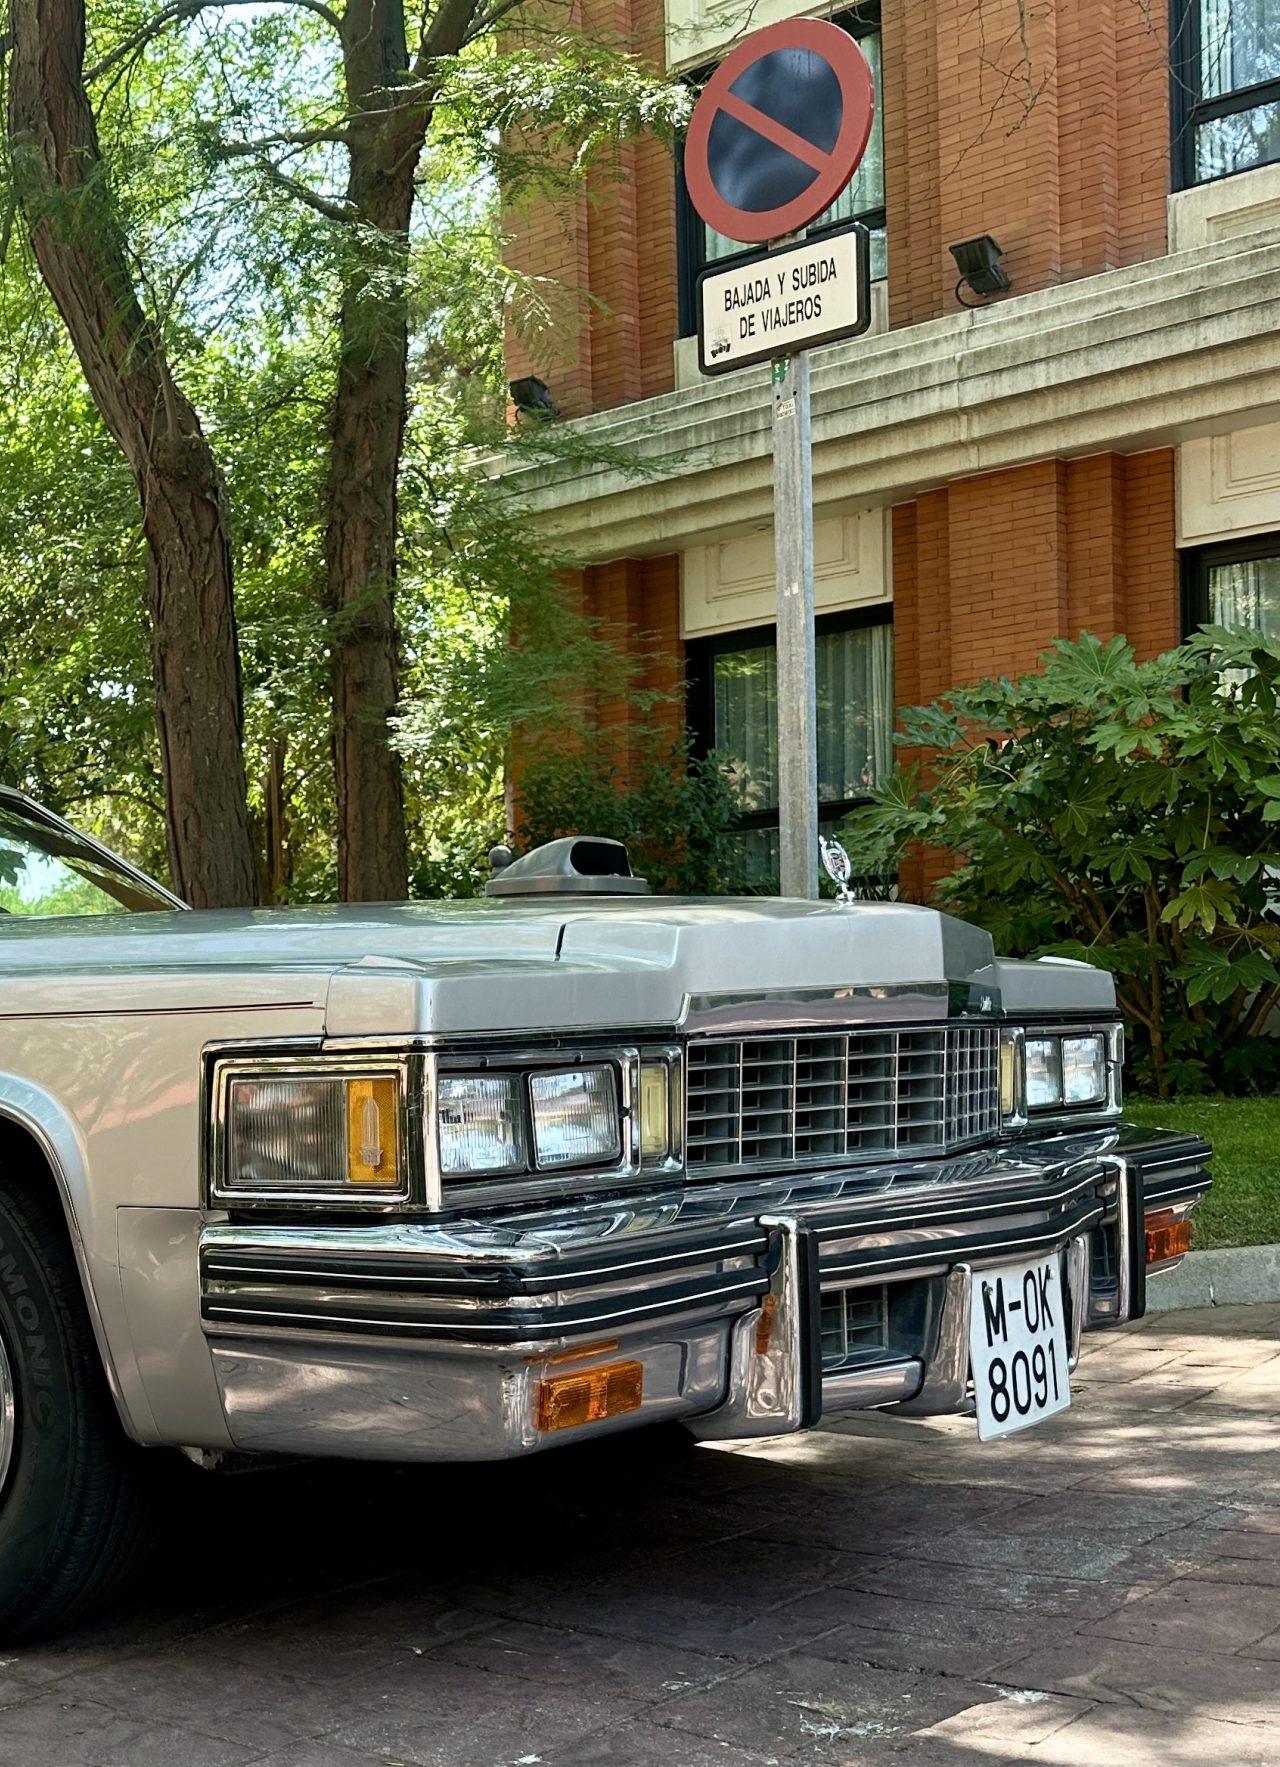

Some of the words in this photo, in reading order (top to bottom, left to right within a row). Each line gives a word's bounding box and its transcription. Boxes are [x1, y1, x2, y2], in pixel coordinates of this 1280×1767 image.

[724, 277, 771, 312] BAJADA
[777, 272, 786, 295] Y
[792, 257, 837, 291] SUBIDA
[739, 314, 756, 339] DE
[761, 294, 822, 332] VIAJEROS
[981, 1264, 1055, 1347] M-OK
[988, 1338, 1059, 1423] 8091
